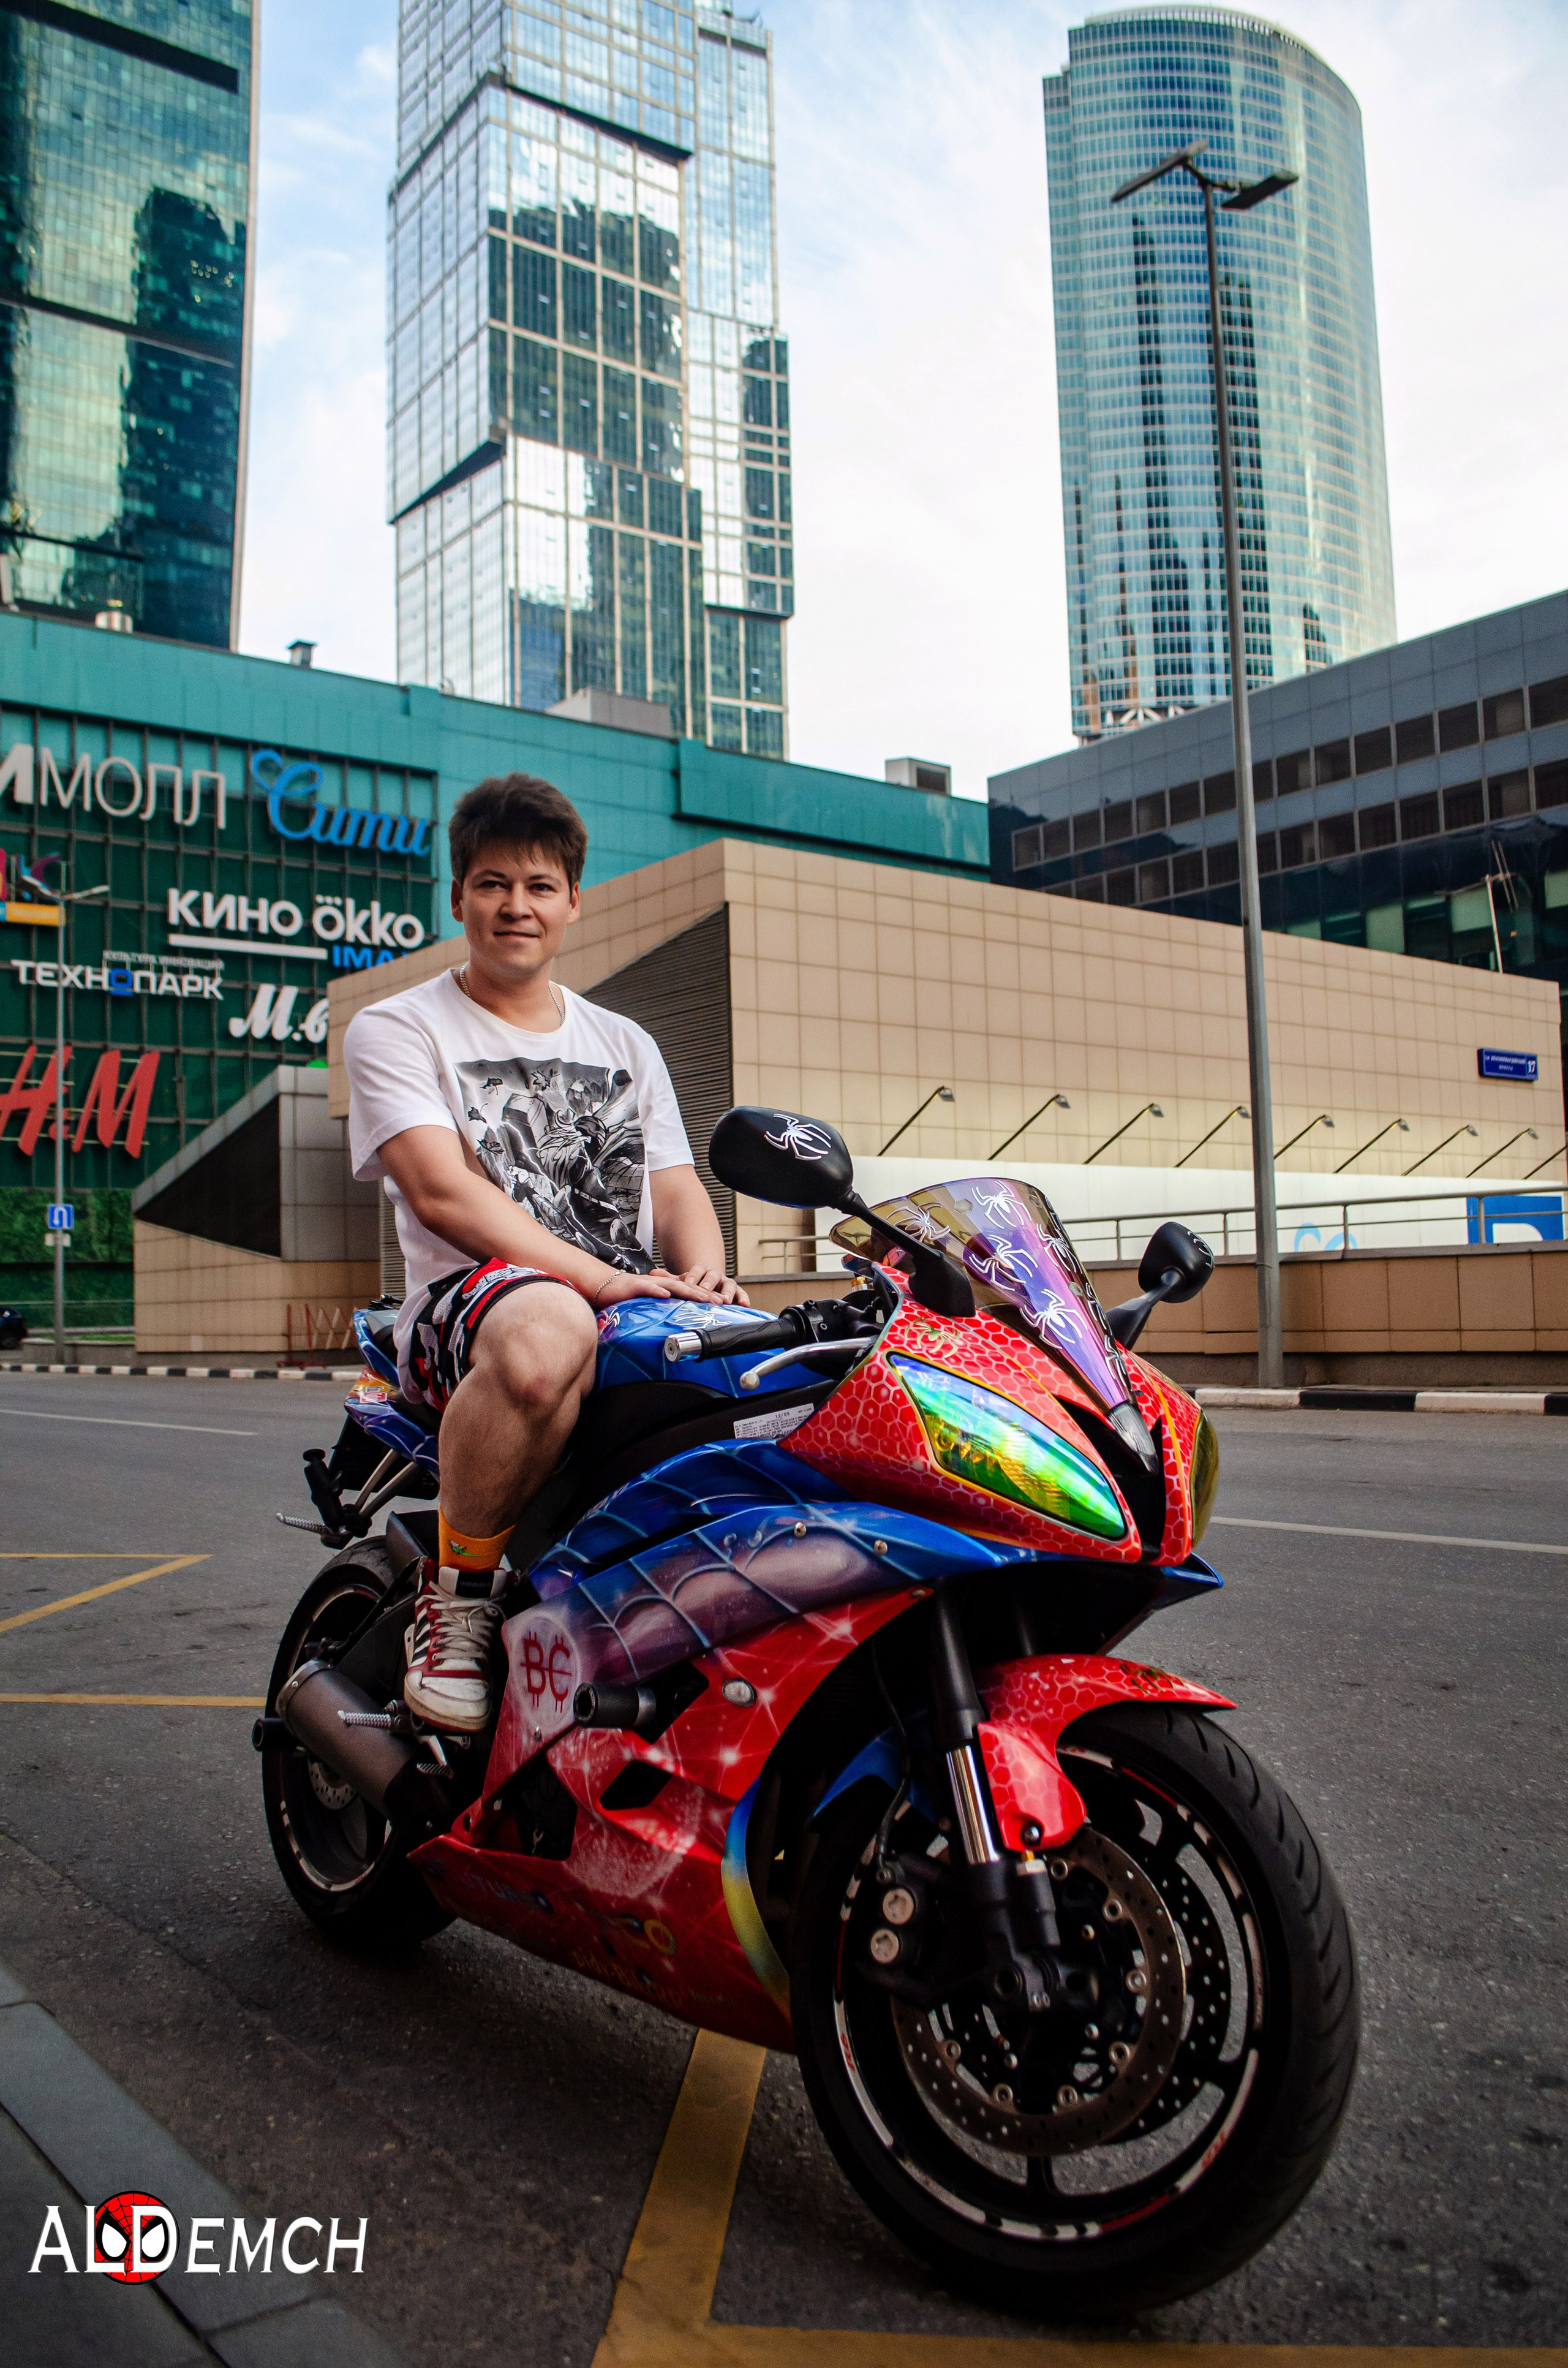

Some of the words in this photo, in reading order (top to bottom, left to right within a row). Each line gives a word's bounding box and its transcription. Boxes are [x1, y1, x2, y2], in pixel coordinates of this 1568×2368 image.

[251, 749, 431, 856] Сити
[168, 888, 303, 937] КИНО
[332, 944, 410, 969] IMA
[10, 959, 224, 1001] ТЕХНОПАРК
[1528, 1060, 1536, 1073] 17
